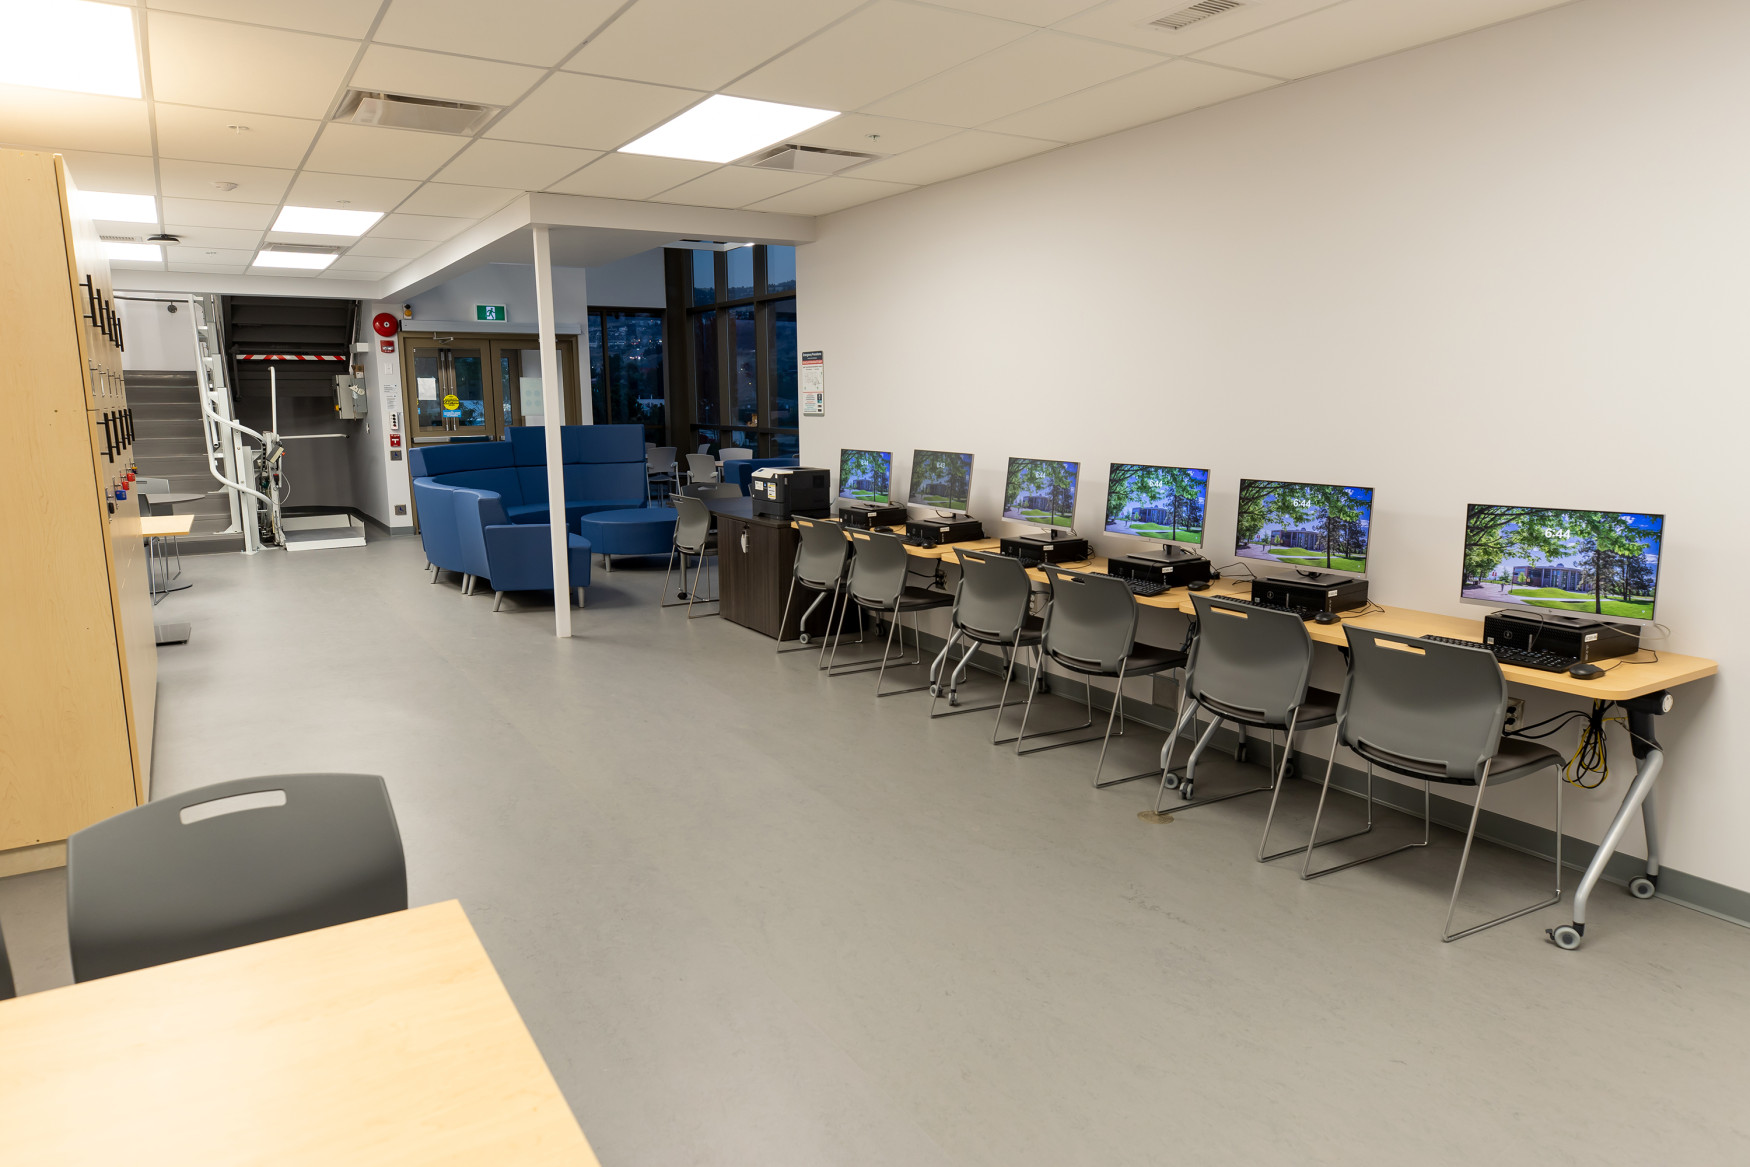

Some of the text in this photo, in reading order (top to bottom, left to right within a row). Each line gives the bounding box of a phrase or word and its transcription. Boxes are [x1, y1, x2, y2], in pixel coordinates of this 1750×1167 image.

[1149, 479, 1162, 488] 6:44
[1293, 498, 1311, 508] 6:44
[1545, 528, 1570, 540] 6:44
